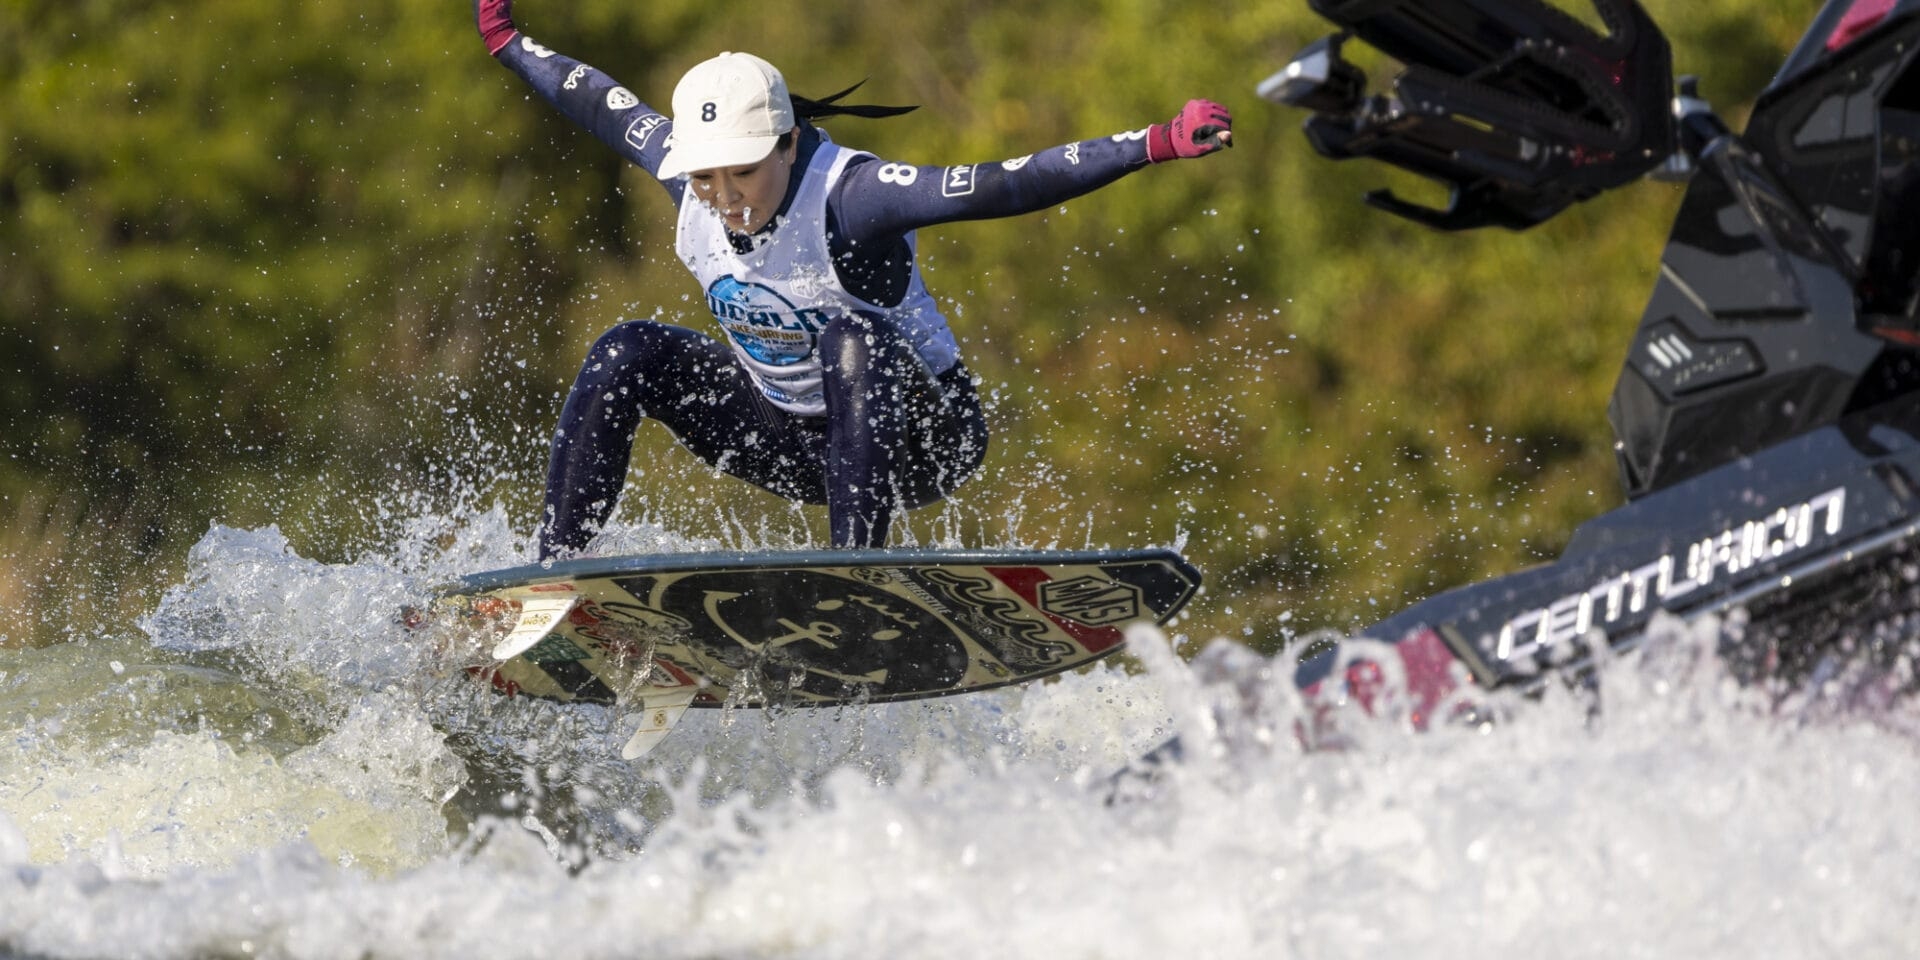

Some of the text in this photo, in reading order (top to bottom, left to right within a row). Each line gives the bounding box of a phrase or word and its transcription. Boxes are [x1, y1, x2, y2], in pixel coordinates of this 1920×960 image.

[701, 101, 717, 122] 8
[877, 162, 918, 186] 8
[1498, 486, 1846, 661] CENTURION
